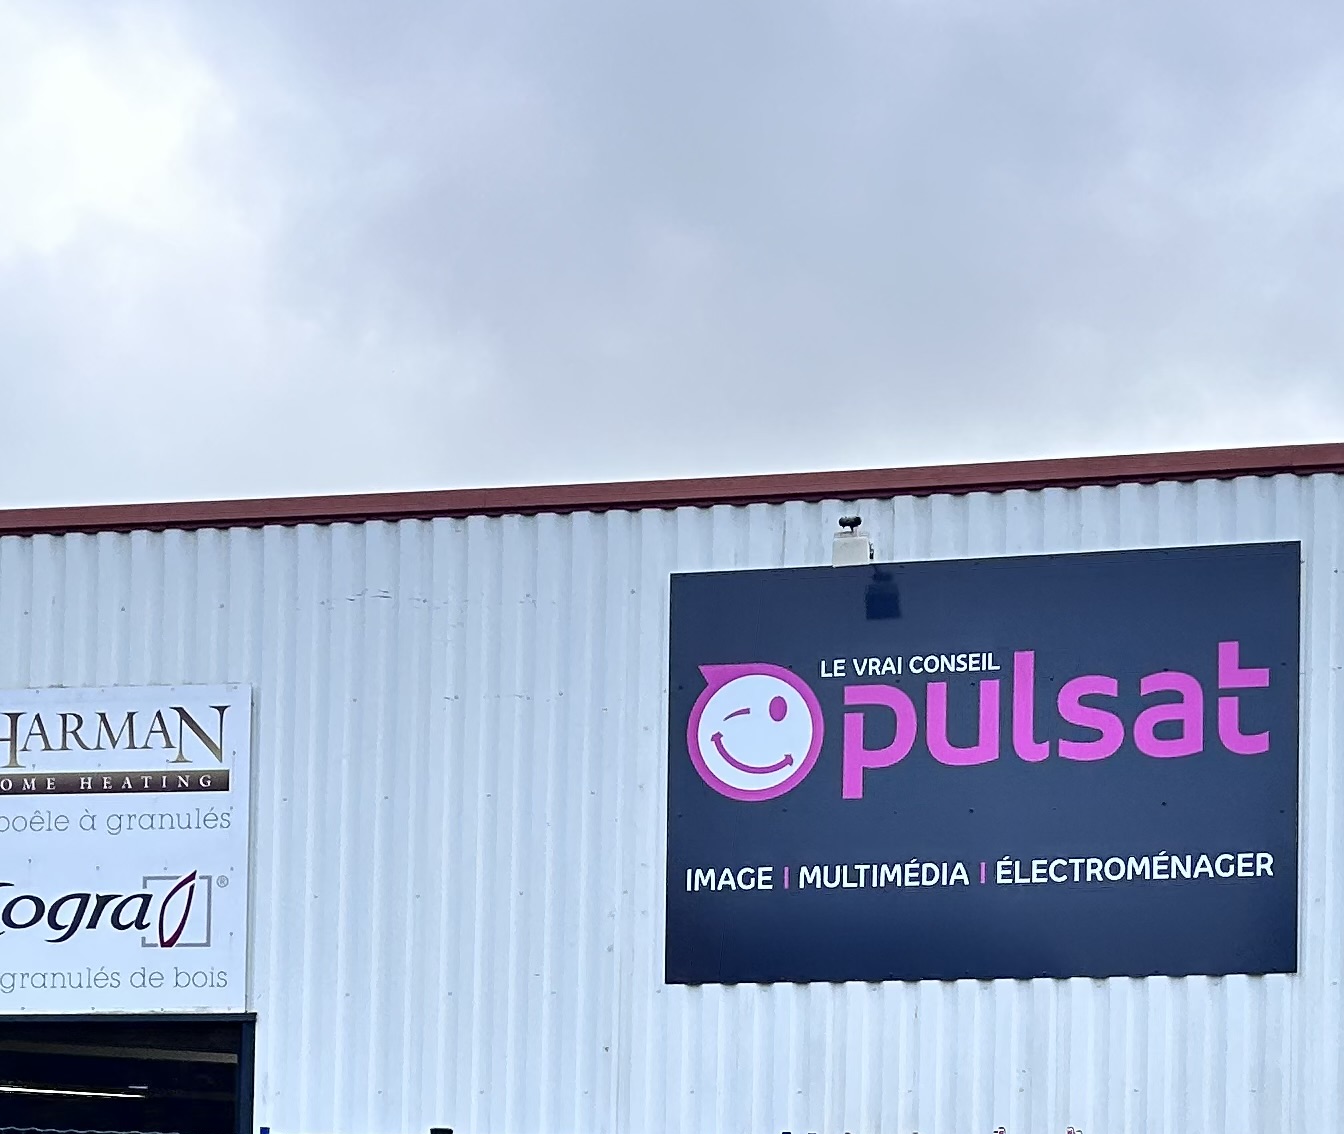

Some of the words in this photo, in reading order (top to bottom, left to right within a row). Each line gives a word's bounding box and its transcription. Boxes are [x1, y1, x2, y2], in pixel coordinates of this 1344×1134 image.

[820, 658, 846, 679] LE
[853, 656, 903, 677] VRAI
[908, 652, 1000, 674] CONSEIL
[841, 640, 1270, 799] pulsat
[80, 774, 212, 790] HEATING
[79, 808, 97, 831] à
[106, 806, 231, 835] granulés
[686, 866, 773, 892] IMAGE
[798, 858, 970, 890] MULTIMÉDIA
[995, 850, 1274, 885] ÉLECTROMÉNAGER
[0, 965, 120, 993] granulés
[129, 967, 164, 988] de
[174, 966, 228, 988] bois
